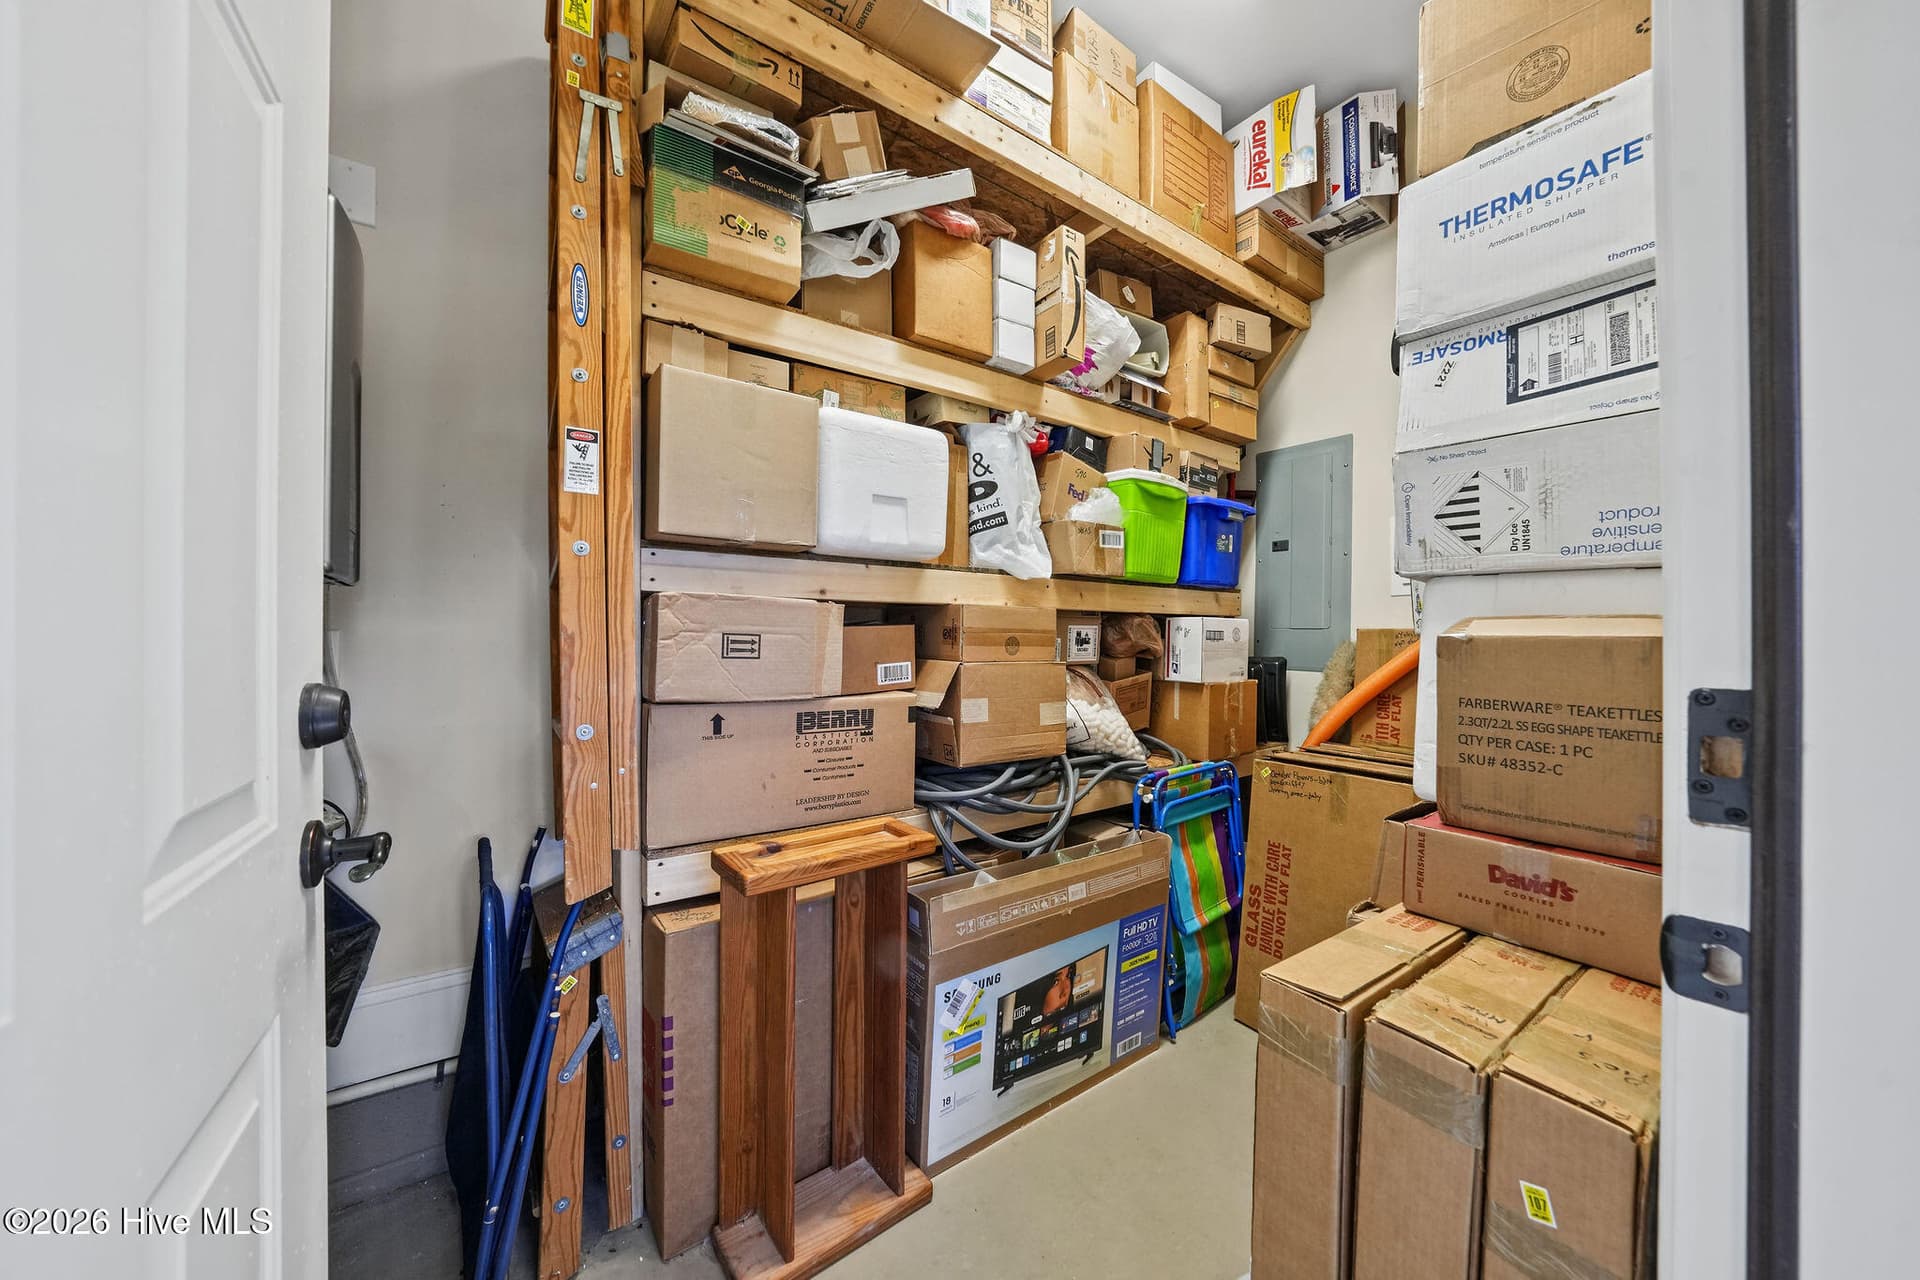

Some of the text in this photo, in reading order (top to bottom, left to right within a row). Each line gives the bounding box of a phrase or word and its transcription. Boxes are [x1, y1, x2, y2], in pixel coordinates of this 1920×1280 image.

[1479, 109, 1600, 170] temperature sensitive product
[1247, 119, 1271, 191] eureka!
[1350, 163, 1359, 192] CHOICE
[1272, 208, 1303, 229] eureka!
[1453, 172, 1619, 243] INSULATED SHIPPER
[1488, 208, 1586, 250] Americas Europe Asia
[576, 276, 584, 314] WERNER
[972, 452, 993, 477] &
[1510, 523, 1520, 552] Dry Ice
[1522, 519, 1531, 551] UN1845
[796, 708, 874, 735] BERRY
[1391, 695, 1402, 722] FLAT
[1567, 704, 1663, 723] TEAKETTLES
[795, 731, 858, 742] PLASTICS
[1458, 716, 1513, 731] 2.3QT/2.2L
[1516, 720, 1529, 731] SS
[1531, 722, 1555, 734] EGG
[1557, 725, 1594, 738] SHAPE
[795, 737, 874, 749] CORPORATION
[1458, 734, 1593, 759] QTY PER CASE: 1 PC
[837, 763, 857, 771] Products
[1458, 752, 1564, 776] SKU# 48352-C
[795, 789, 870, 806] LEADERSHIP BY DESIGN
[1417, 831, 1426, 889] PERISHABLE
[1488, 864, 1578, 902] David's
[1259, 840, 1281, 956] HANDLE WITH CARE
[1273, 845, 1292, 960] DO NOT LAY FLAT
[1504, 889, 1555, 908] COOKIES
[1123, 916, 1158, 938] Full HD TV
[1245, 883, 1262, 948] GLASS
[1458, 892, 1606, 937] BAKED FRESH SINCE 1979
